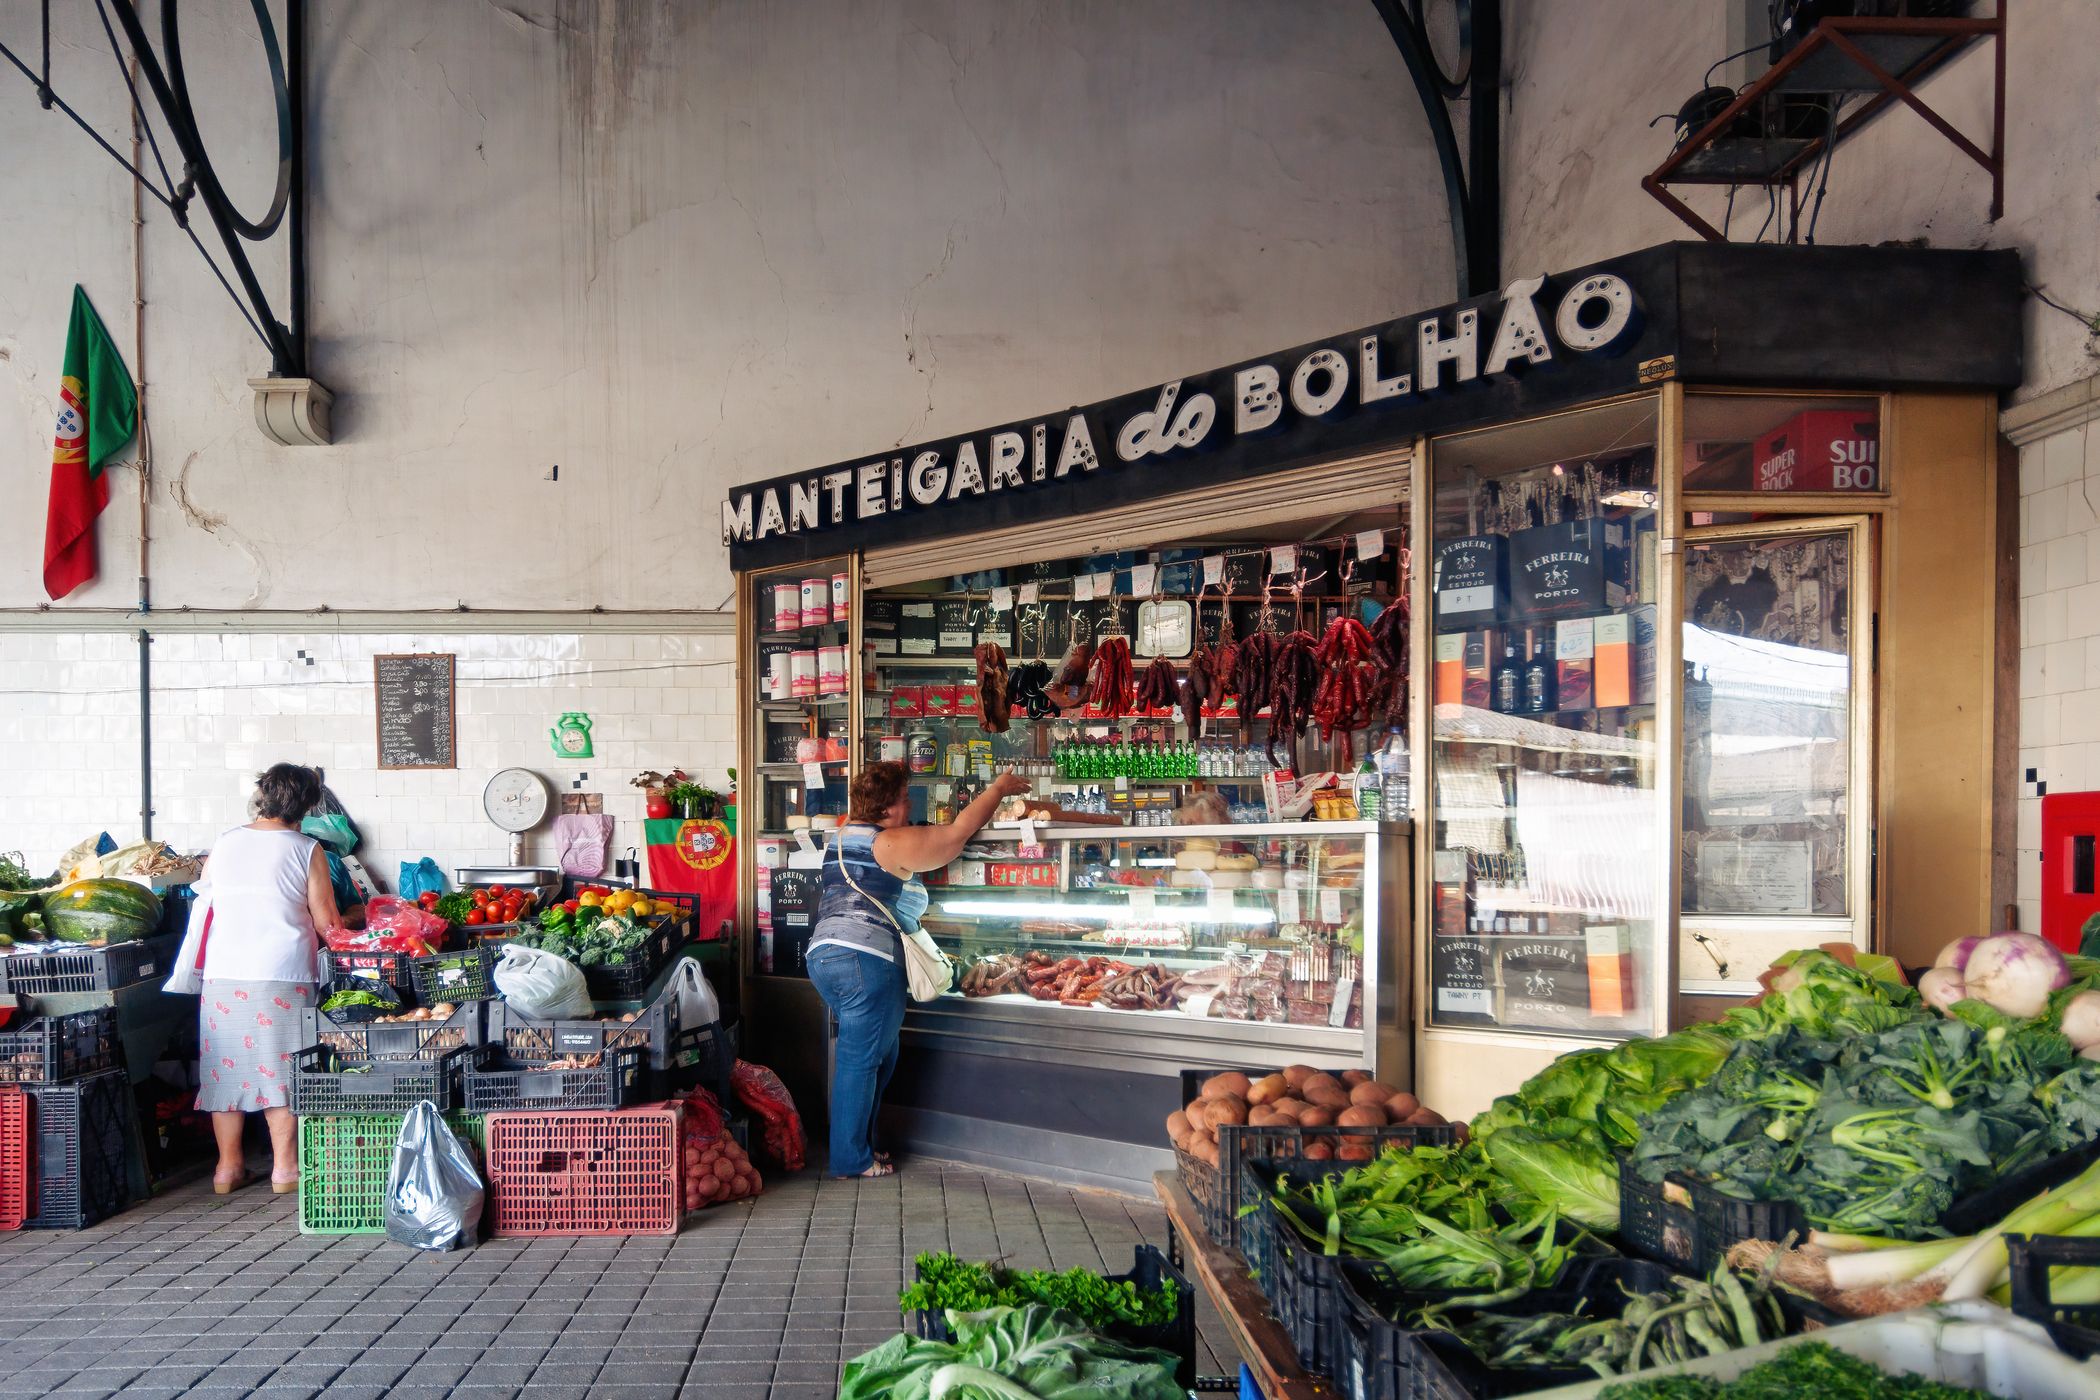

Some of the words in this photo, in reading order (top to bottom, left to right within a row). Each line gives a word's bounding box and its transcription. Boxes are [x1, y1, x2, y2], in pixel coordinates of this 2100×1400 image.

[720, 413, 1101, 547] MANTEIGARIA
[1116, 378, 1216, 463] do
[1233, 272, 1634, 436] BOLHÃO
[1760, 448, 1796, 481] SUPER
[1441, 540, 1492, 556] FERREIRA
[1525, 551, 1590, 572] FERREIRA
[1448, 571, 1485, 580] PORTO
[1448, 580, 1485, 588] ESTOJO
[1535, 588, 1580, 599] PORTO
[774, 871, 807, 884] FERREIRA
[1441, 942, 1490, 956] FERREIRA
[1505, 944, 1577, 964] FERREIRA
[1447, 981, 1483, 989] ESTOJO
[1514, 1002, 1567, 1012] PORTO
